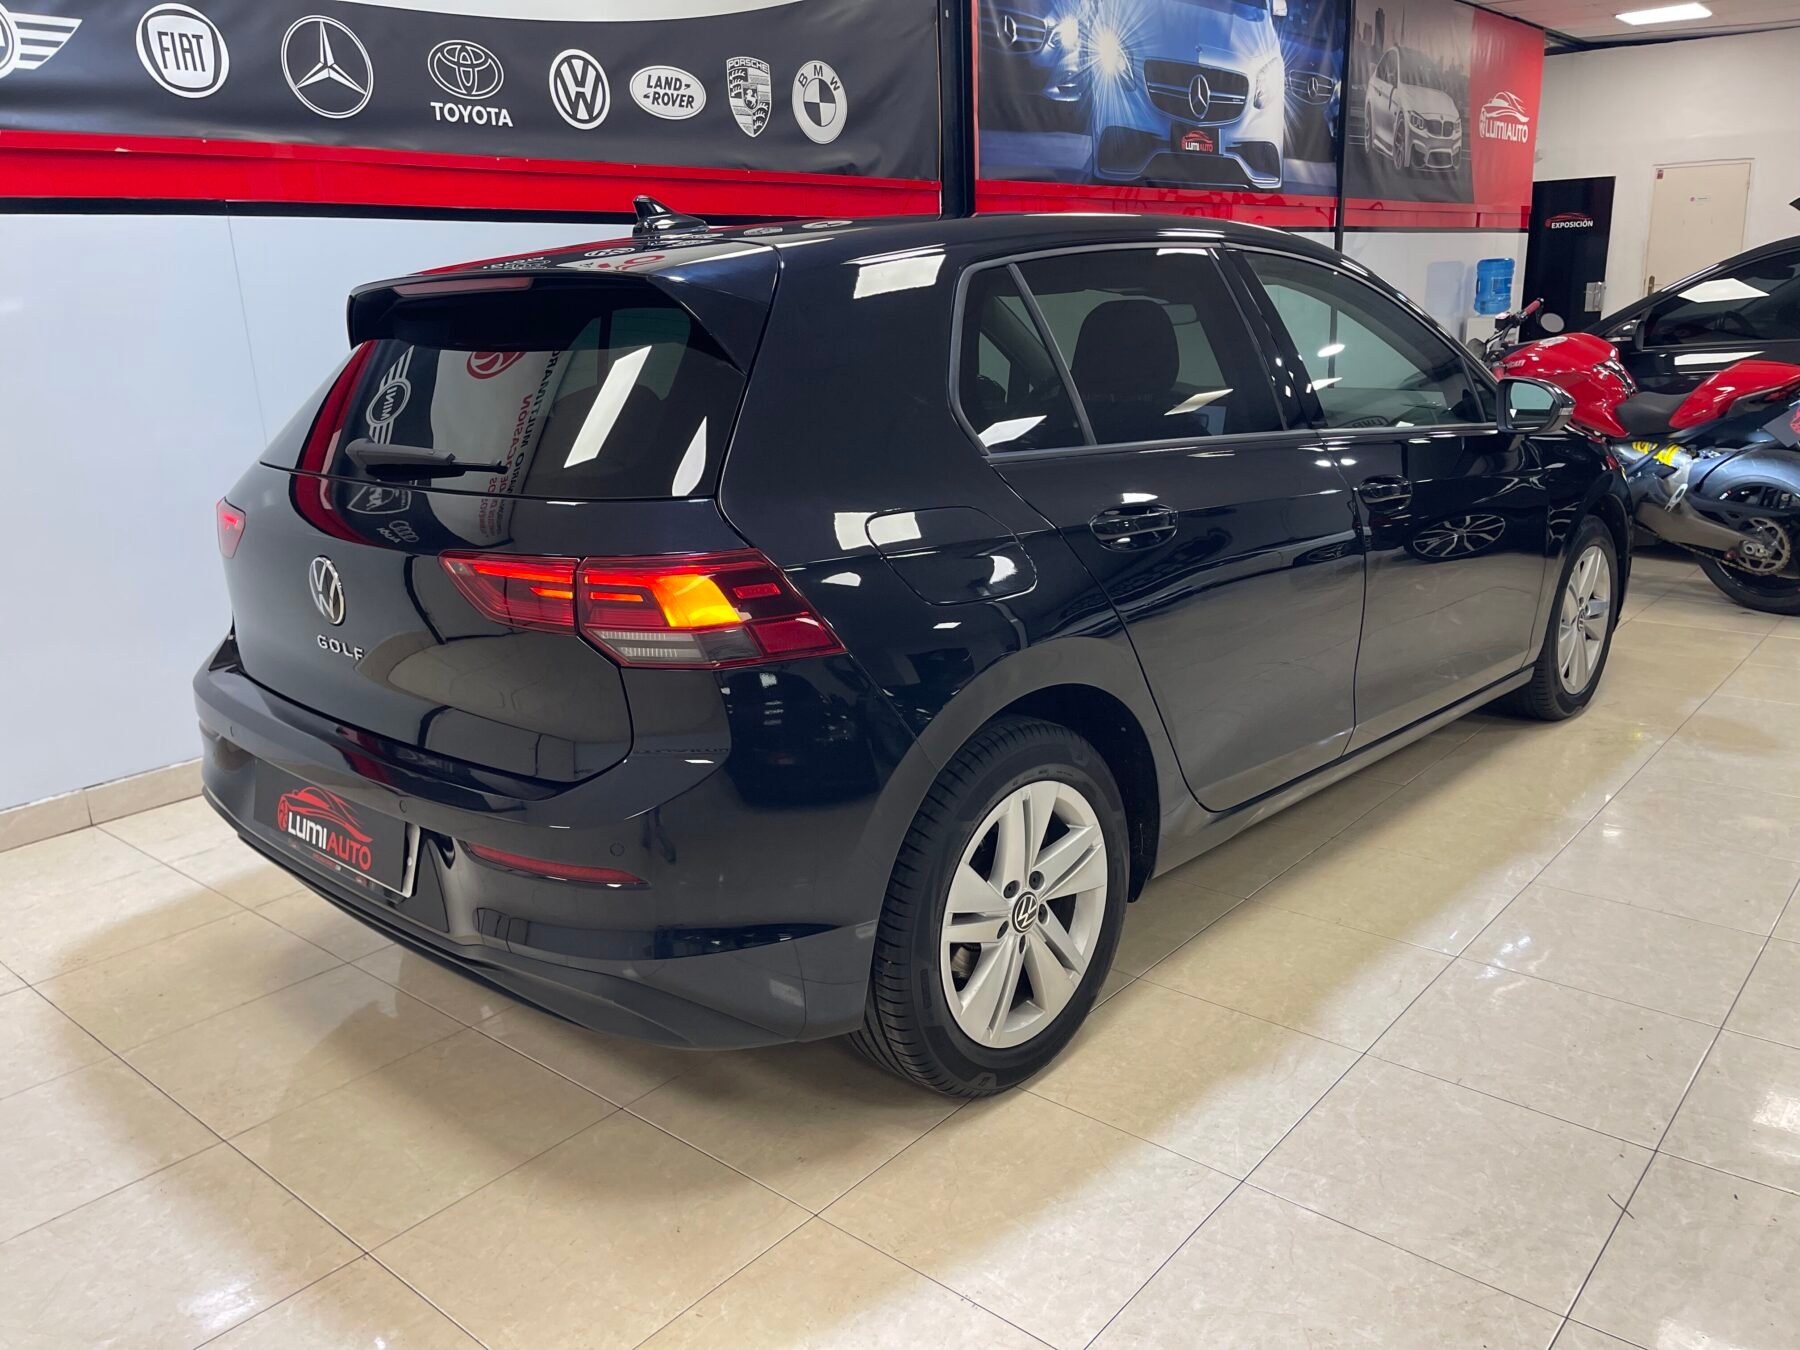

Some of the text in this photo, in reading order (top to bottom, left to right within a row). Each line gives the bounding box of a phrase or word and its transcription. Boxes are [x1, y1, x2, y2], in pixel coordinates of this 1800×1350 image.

[158, 30, 206, 73] FIAT
[728, 58, 769, 73] PORSCHE
[798, 64, 840, 92] BMW
[430, 101, 514, 128] TOYOTA
[1551, 218, 1594, 230] EXPOSICIÓN
[317, 634, 364, 661] GOLF
